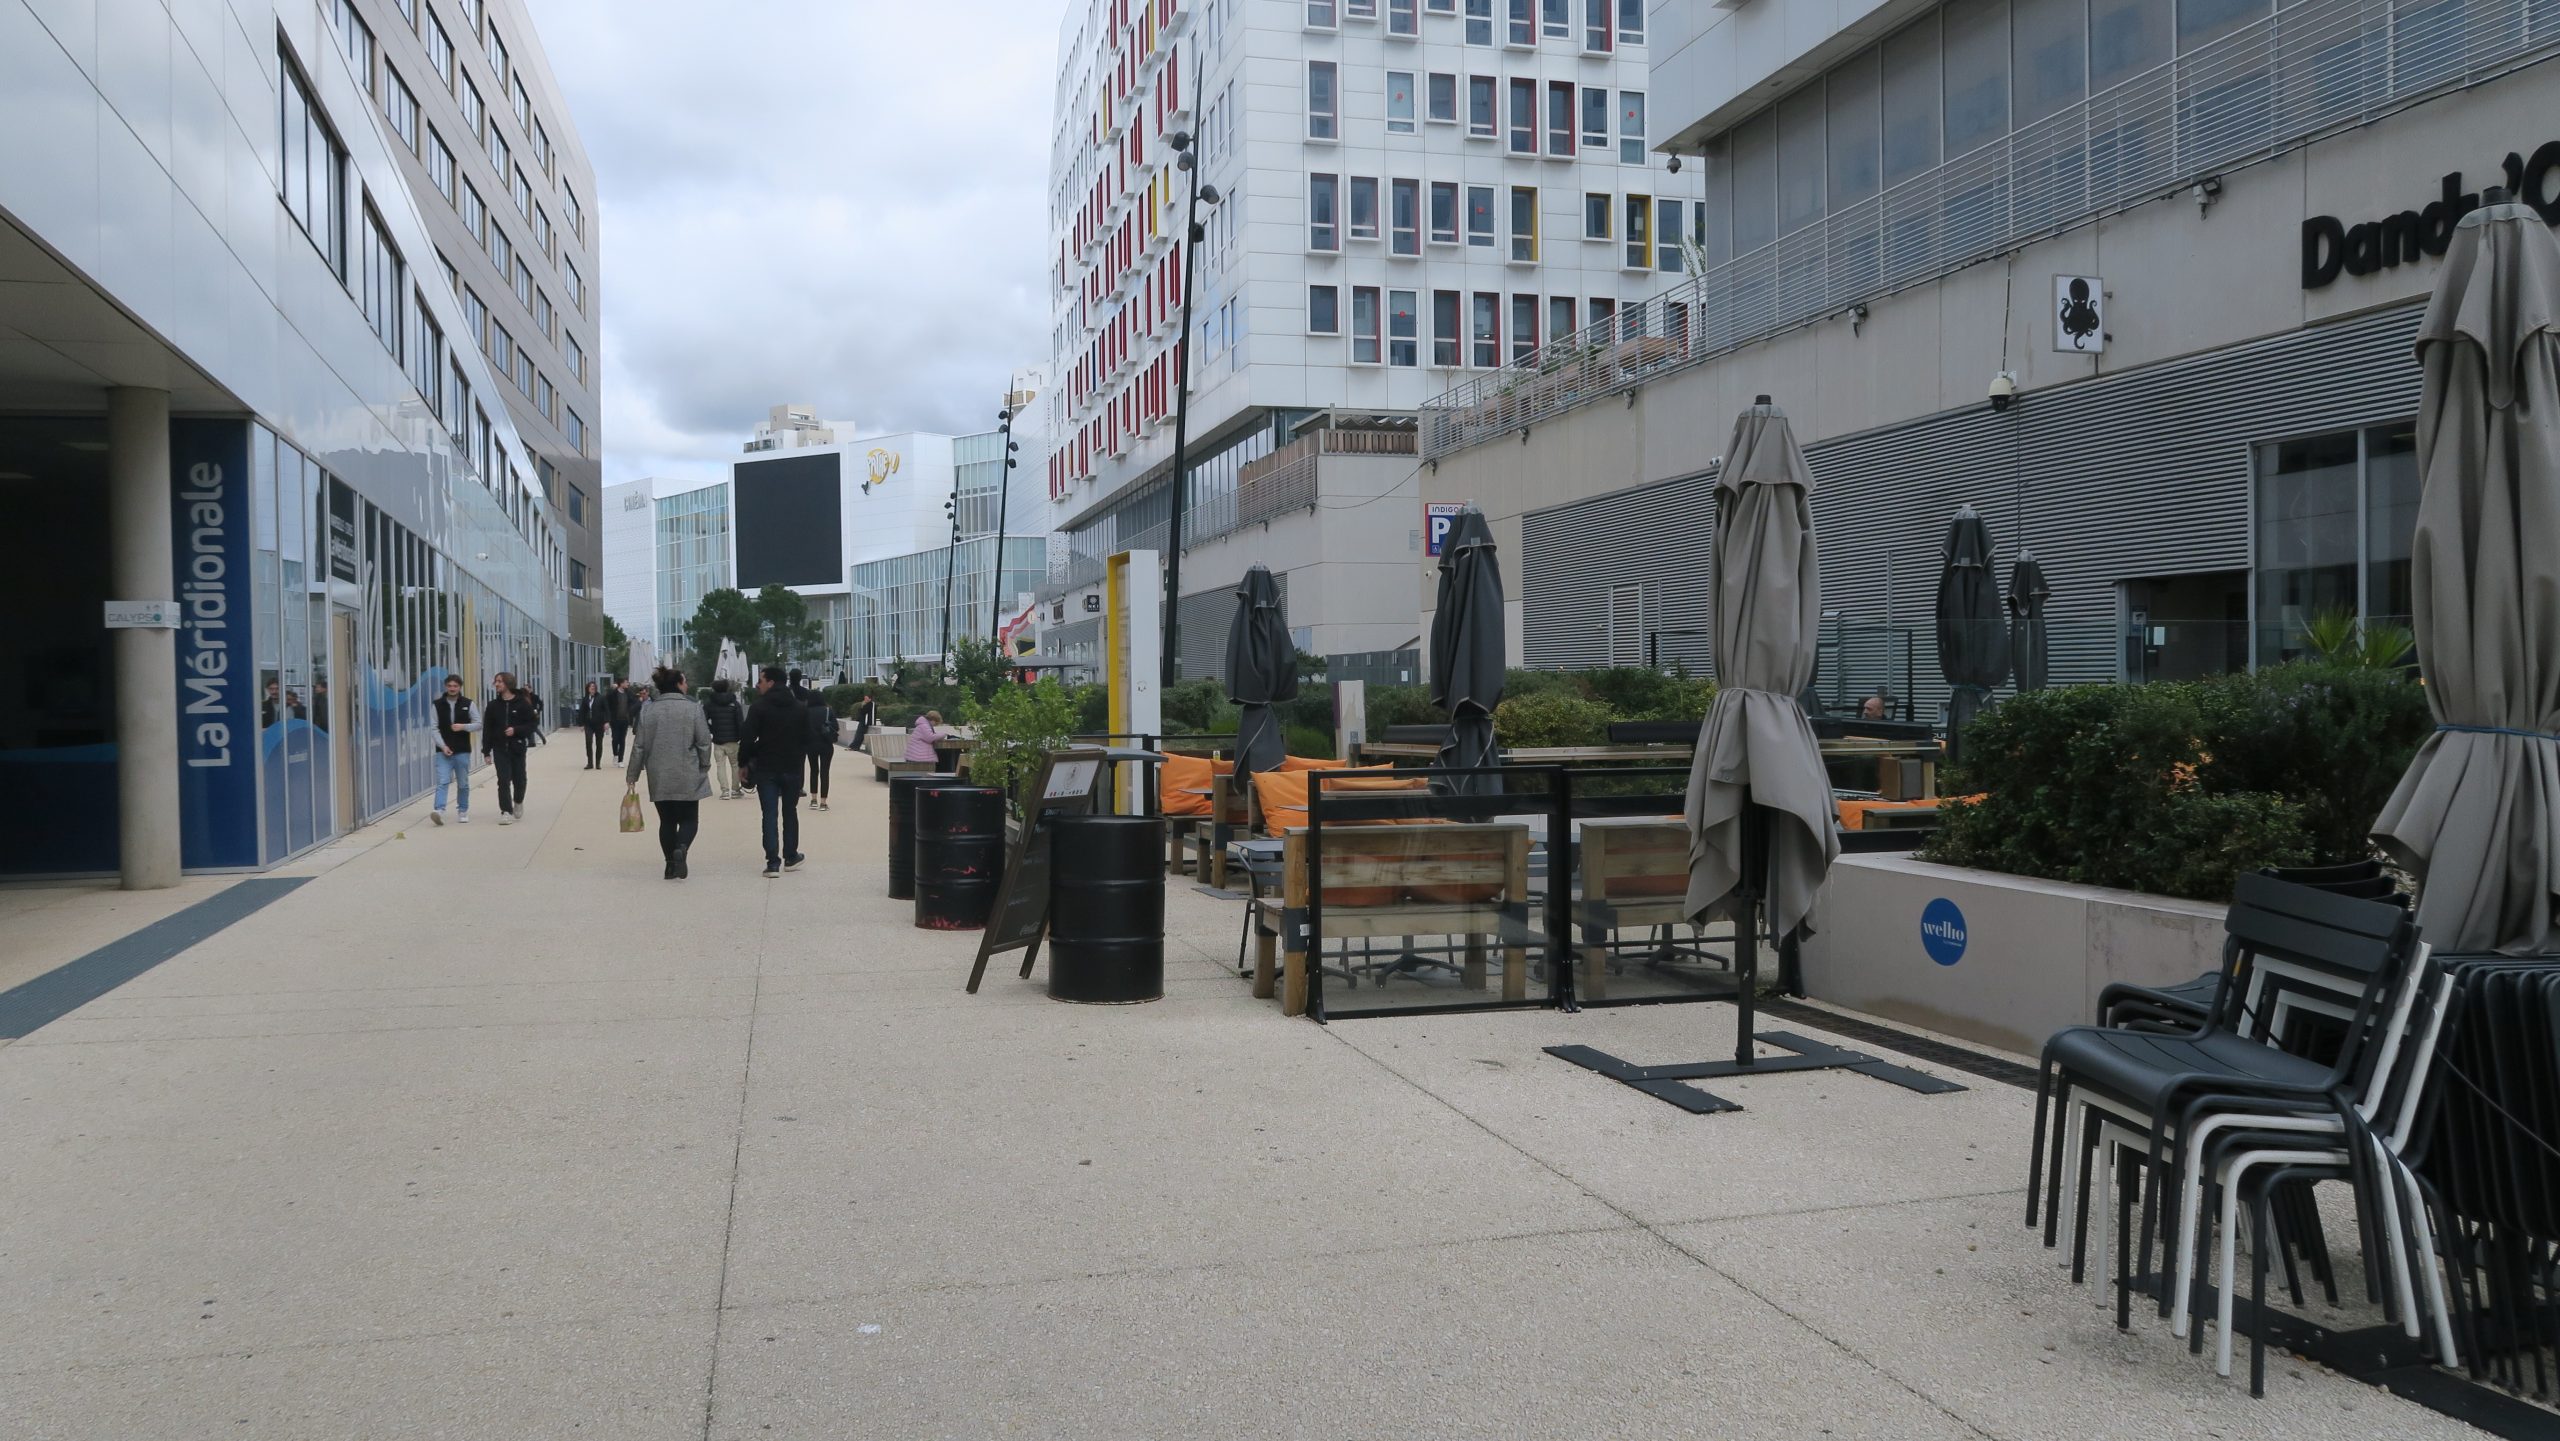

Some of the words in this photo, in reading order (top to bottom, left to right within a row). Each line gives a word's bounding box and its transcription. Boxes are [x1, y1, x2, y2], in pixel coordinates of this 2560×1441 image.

[2302, 140, 2560, 289] Dand'O
[1432, 517, 1450, 544] P
[181, 462, 229, 714] Méridionale
[187, 722, 231, 767] La
